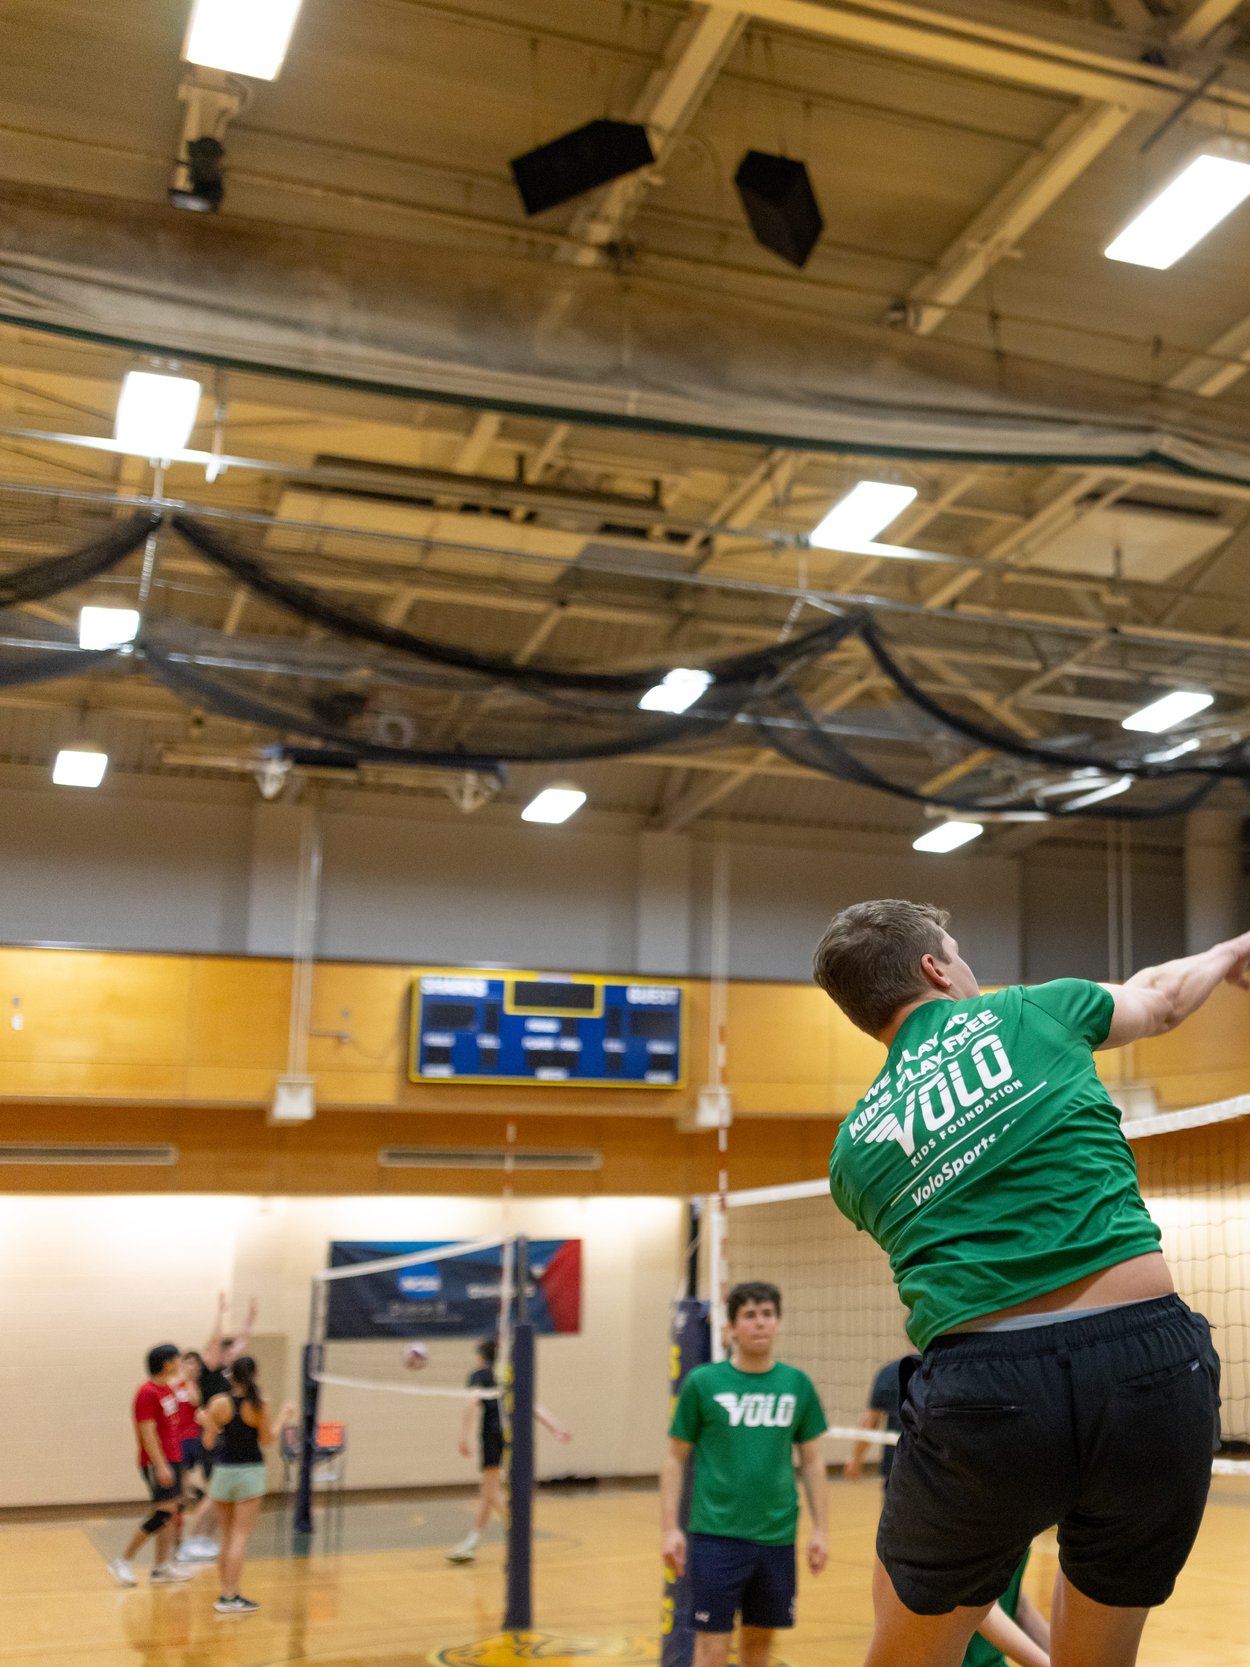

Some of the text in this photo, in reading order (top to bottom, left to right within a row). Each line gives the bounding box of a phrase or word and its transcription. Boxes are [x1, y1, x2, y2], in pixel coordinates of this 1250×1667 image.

[849, 1009, 999, 1139] KIDS PLAY FREE
[864, 1070, 892, 1103] WE
[864, 1034, 1013, 1158] VOLO
[910, 1079, 1024, 1167] KIDS FOUNDATION
[911, 1133, 997, 1207] VoloSports
[713, 1391, 797, 1428] VOLO
